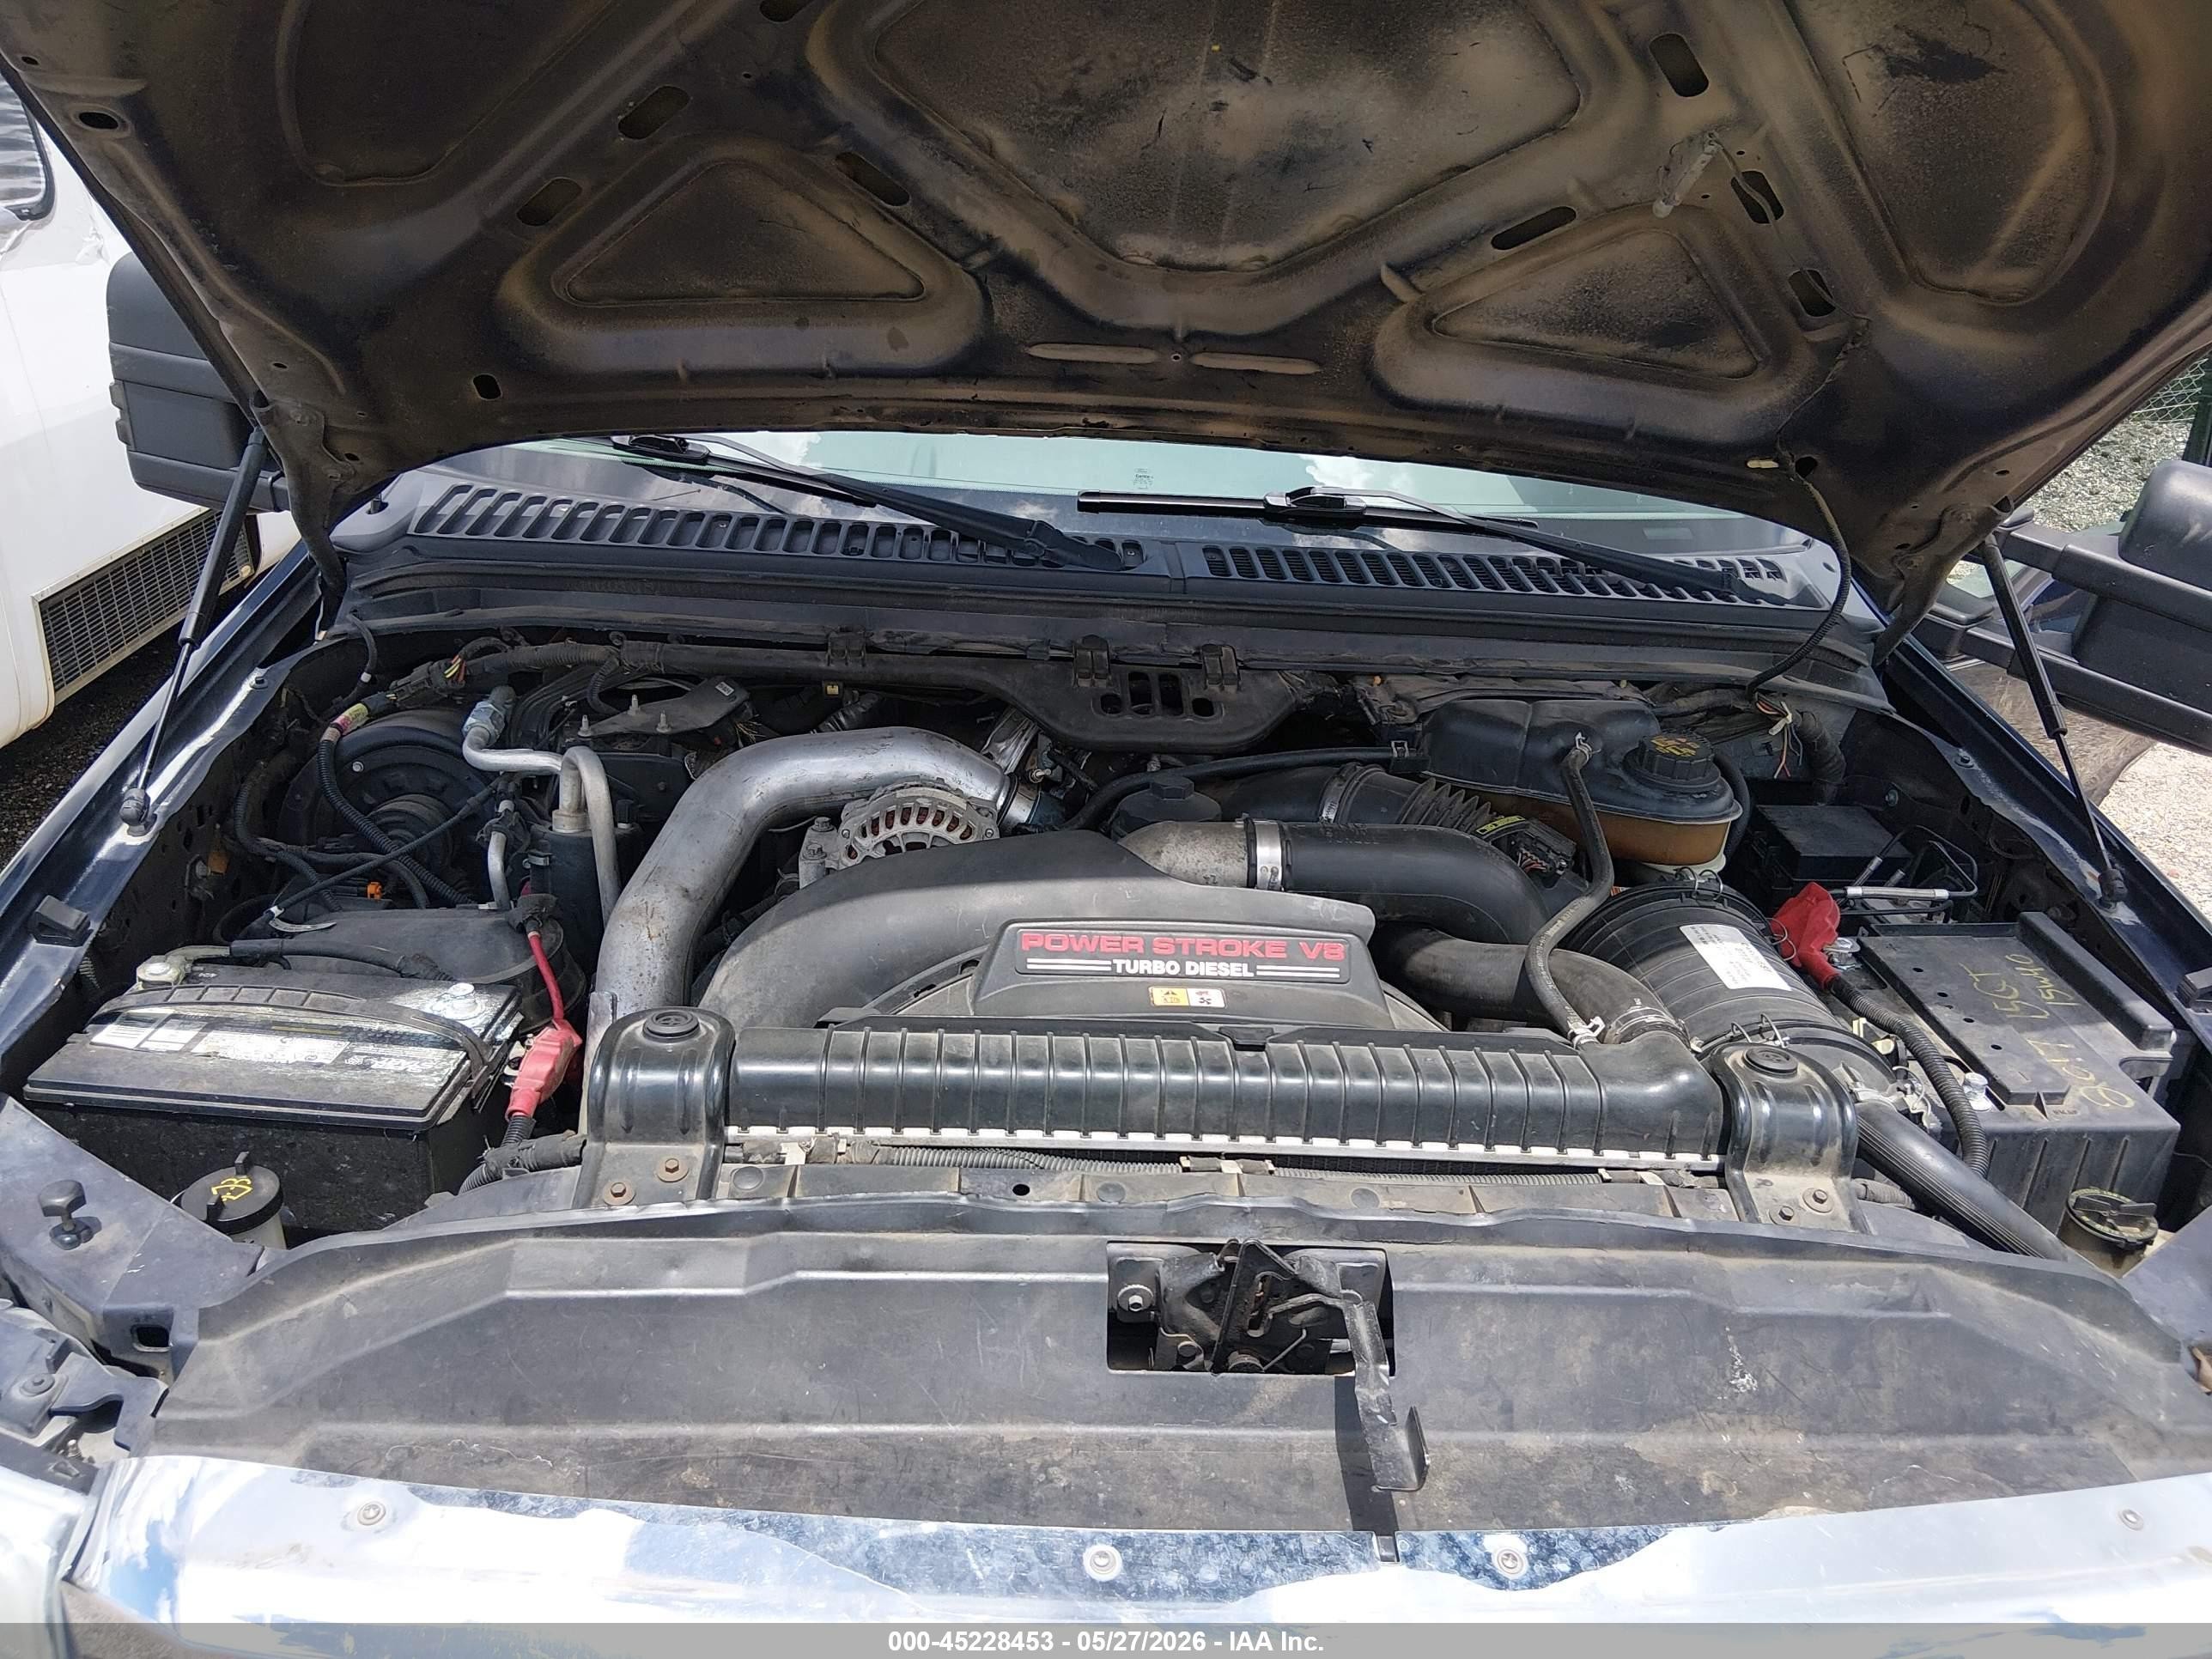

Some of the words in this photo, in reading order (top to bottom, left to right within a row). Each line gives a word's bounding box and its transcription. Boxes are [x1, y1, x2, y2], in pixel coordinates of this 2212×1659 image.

[1021, 933, 1145, 954] POWER
[1152, 937, 1287, 958] STROKE
[1299, 941, 1346, 962] V8
[1112, 958, 1181, 976] TURBO
[1185, 960, 1255, 977] DIESEL
